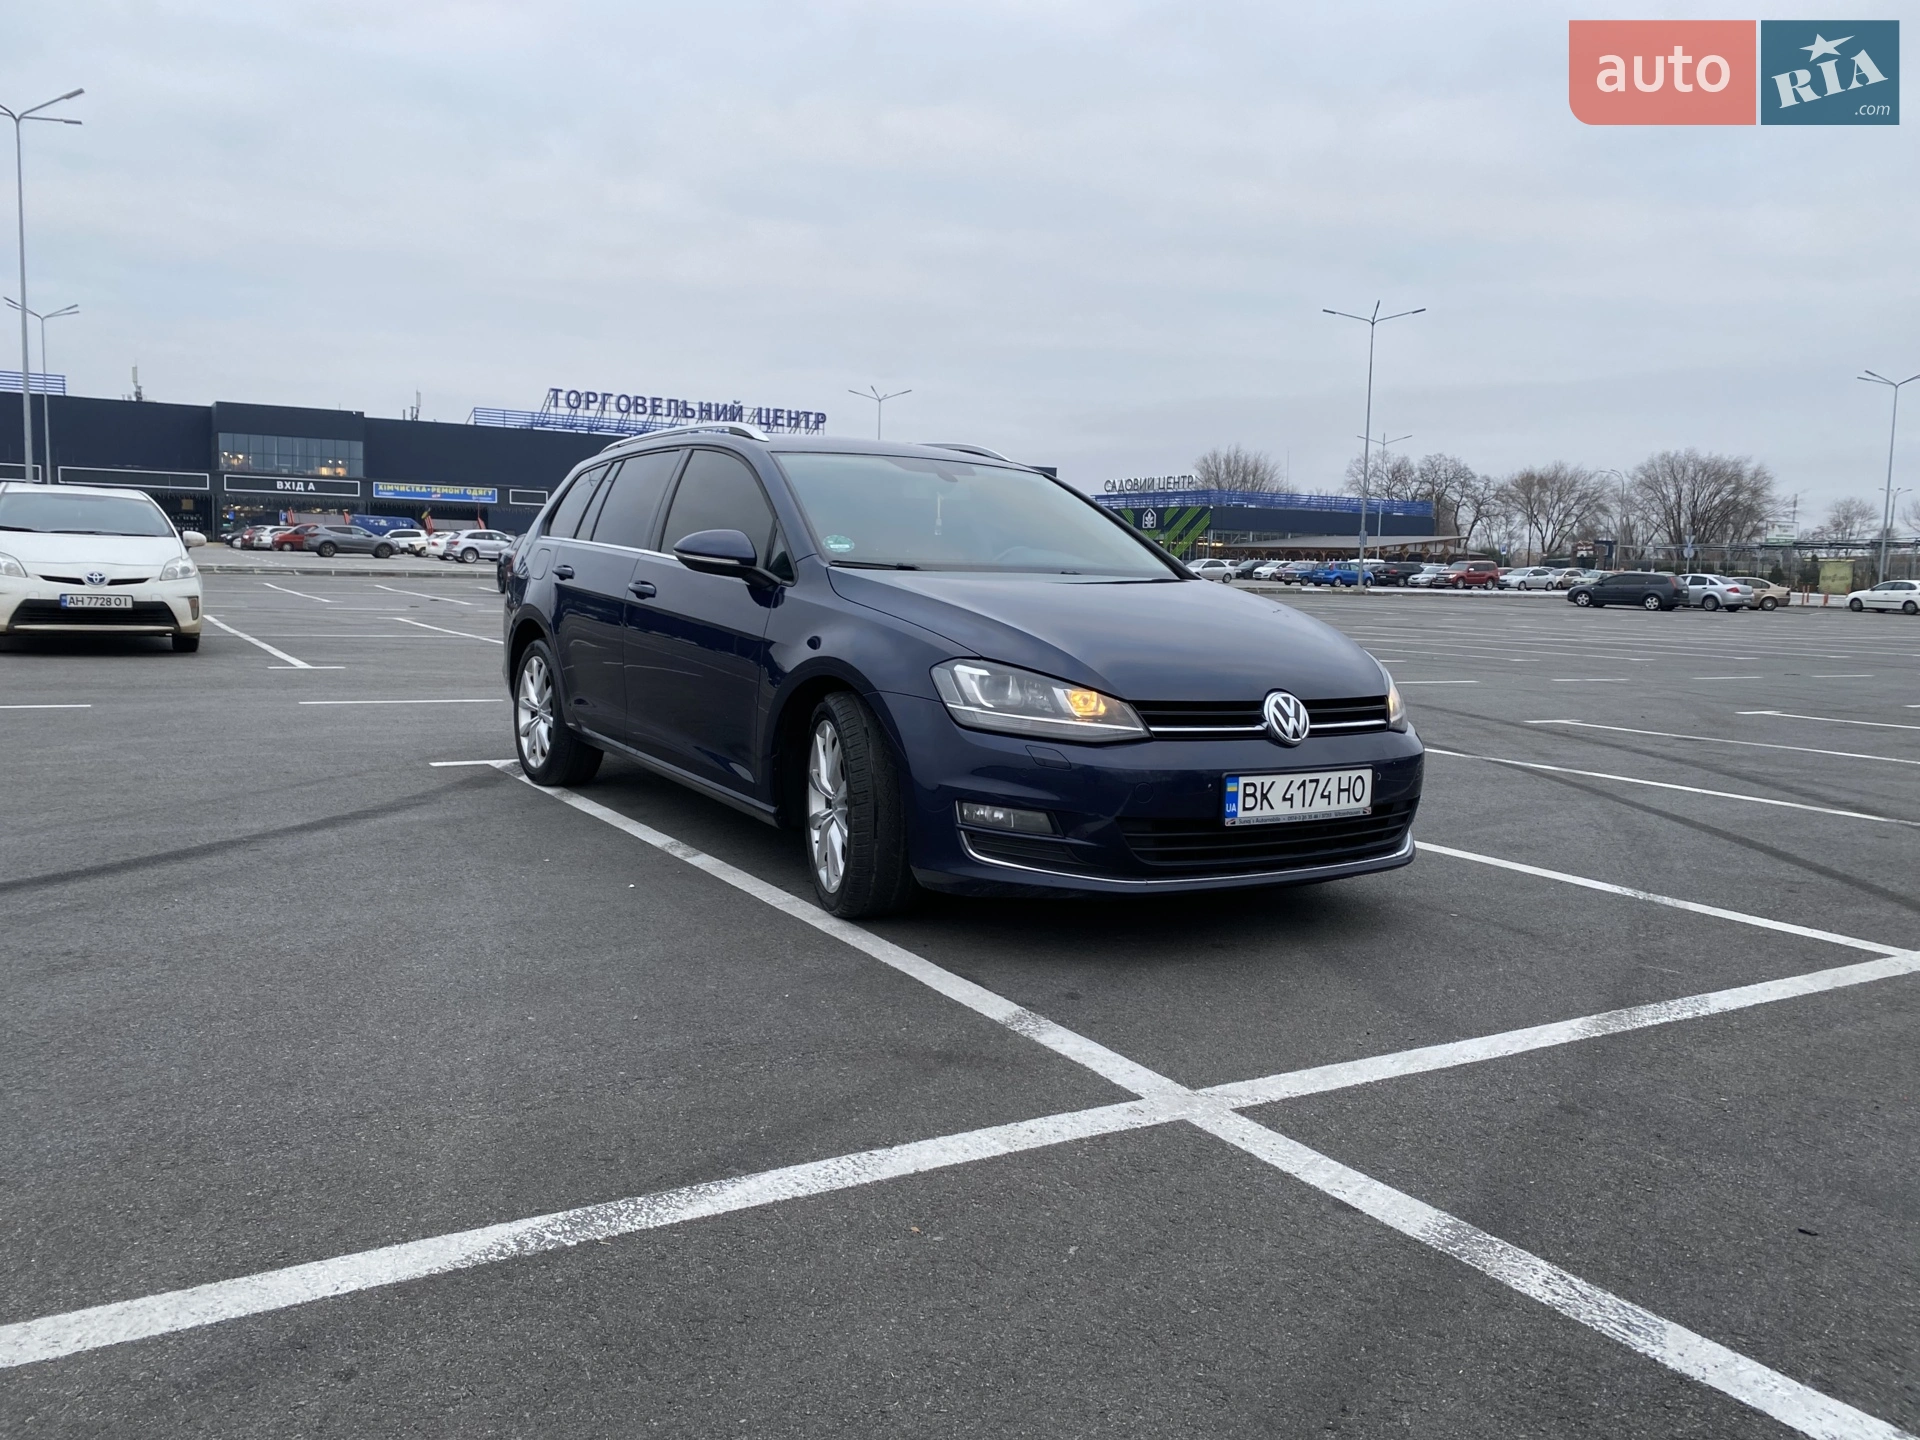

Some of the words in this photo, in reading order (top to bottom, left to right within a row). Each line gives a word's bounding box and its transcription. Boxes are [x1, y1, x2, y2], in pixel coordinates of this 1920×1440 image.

[549, 387, 744, 422] ТОРГОВЕЛЬНИЙ
[757, 406, 828, 431] ЦЕНТР
[276, 480, 305, 492] ВХІД
[1158, 474, 1194, 491] ЦЕНТР
[68, 597, 85, 606] AH
[86, 597, 112, 607] 7728
[1242, 780, 1276, 812] BK
[1281, 777, 1332, 809] 4174
[1226, 803, 1237, 813] UA
